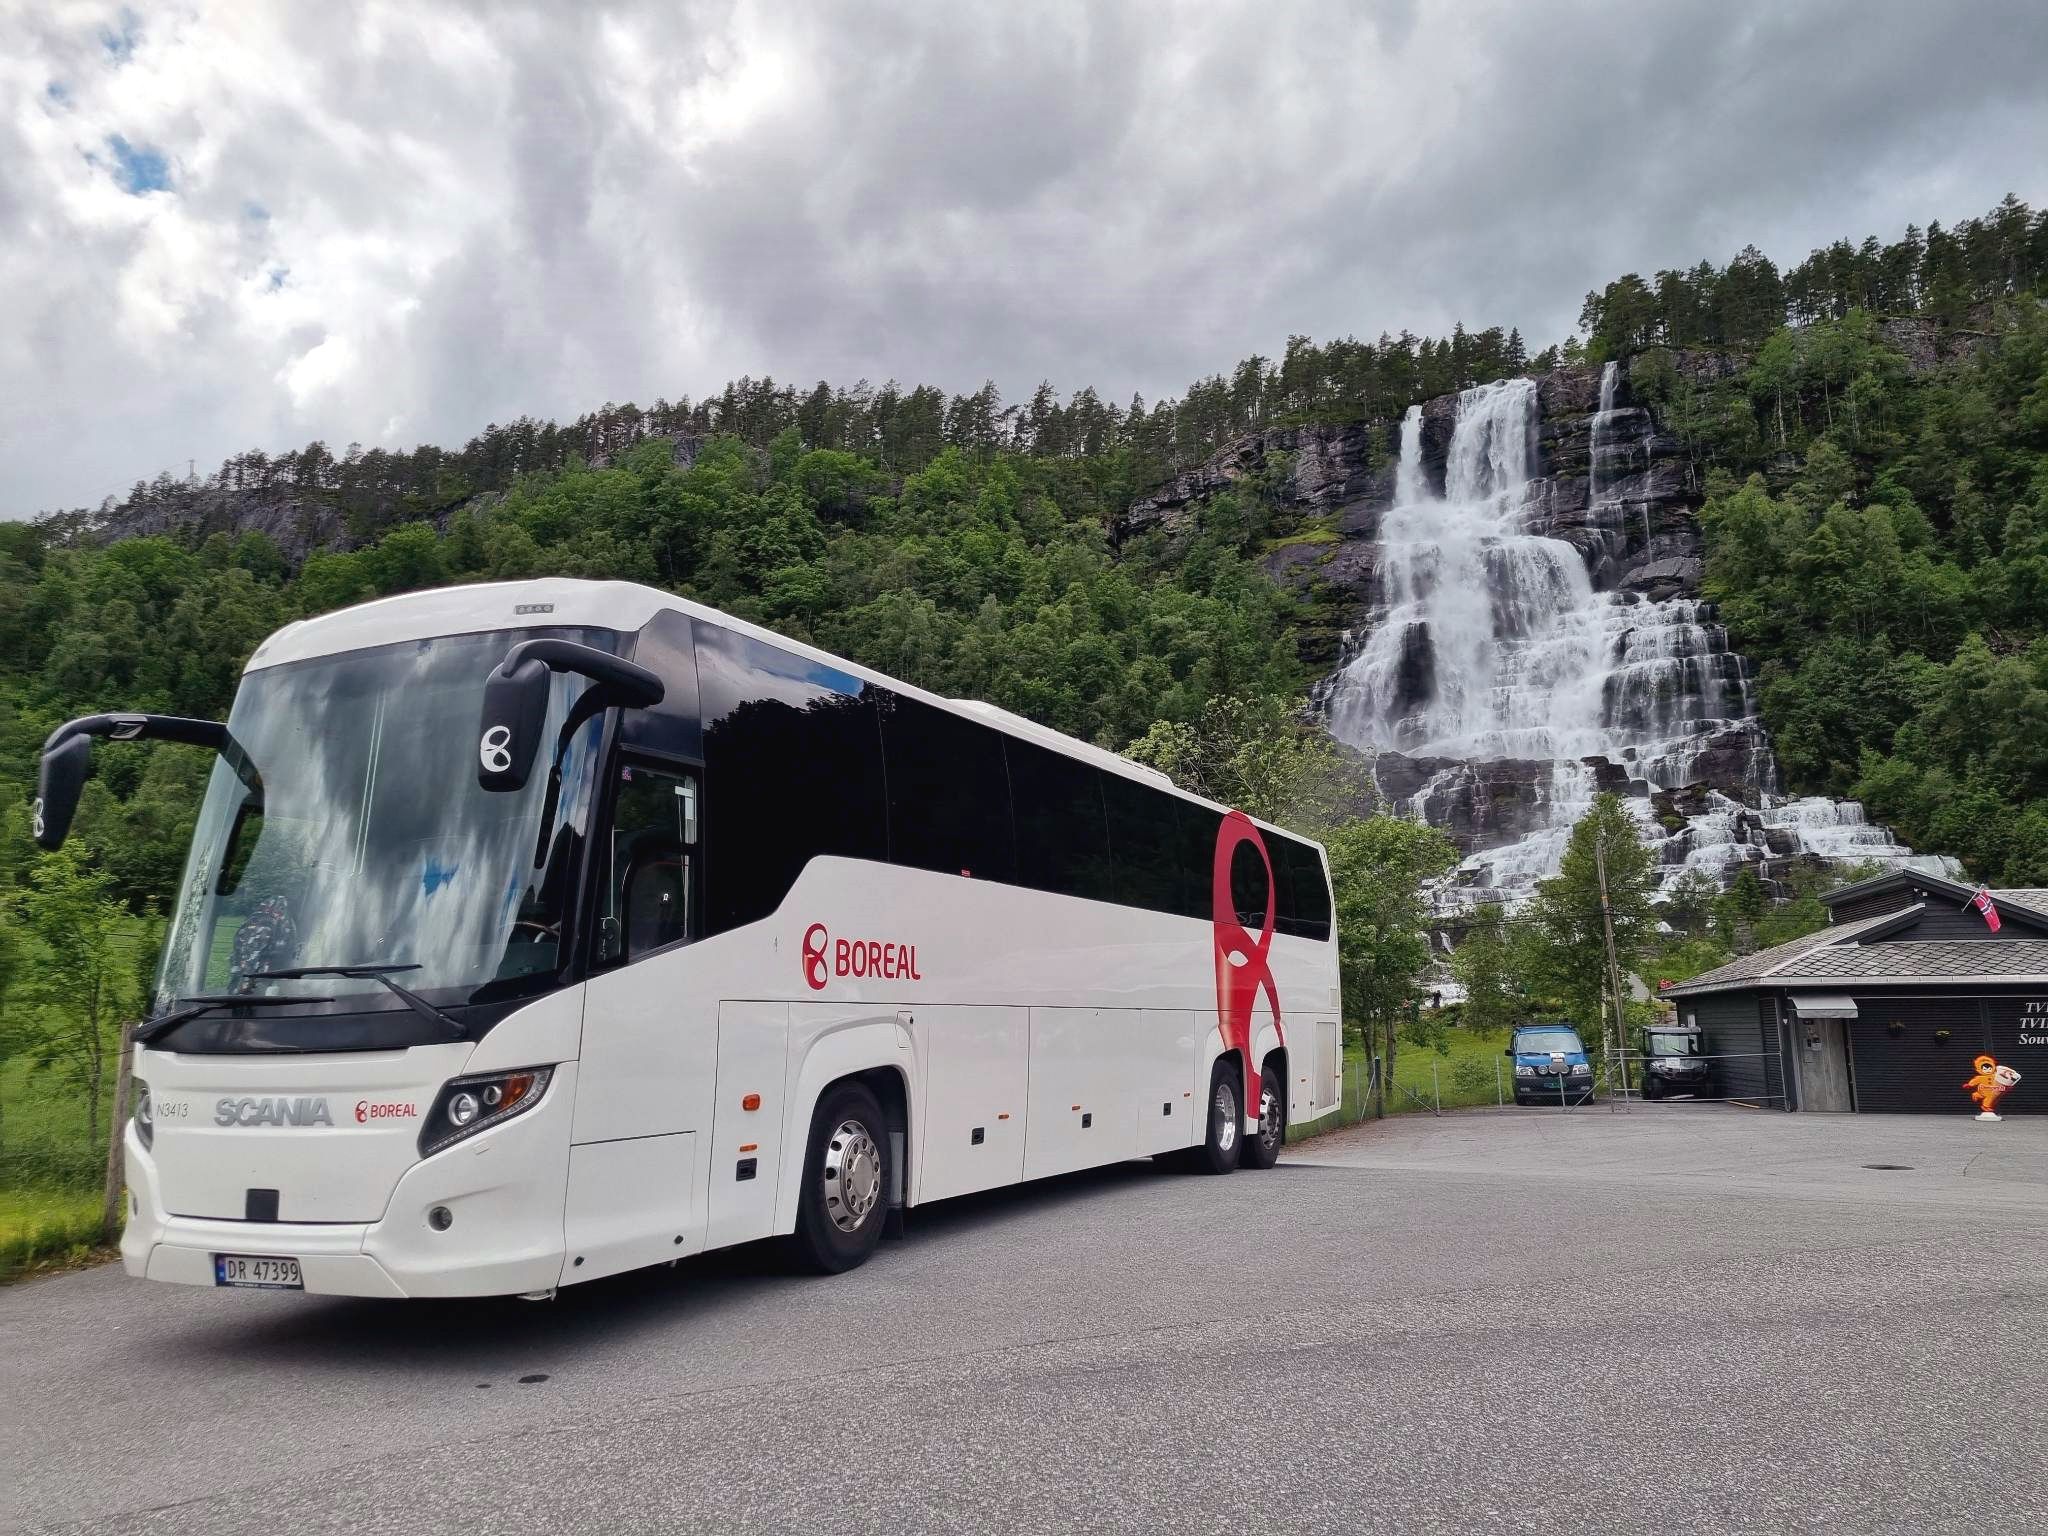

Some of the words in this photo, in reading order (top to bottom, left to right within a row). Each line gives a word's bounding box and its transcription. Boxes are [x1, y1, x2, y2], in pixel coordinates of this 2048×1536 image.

[836, 939, 920, 981] BOREAL
[2019, 1017, 2048, 1029] TVI
[156, 1103, 189, 1118] N3413
[214, 1098, 335, 1127] SCANIA
[370, 1103, 418, 1118] BOREAL
[228, 1260, 246, 1279] DR
[253, 1261, 299, 1282] 47399
